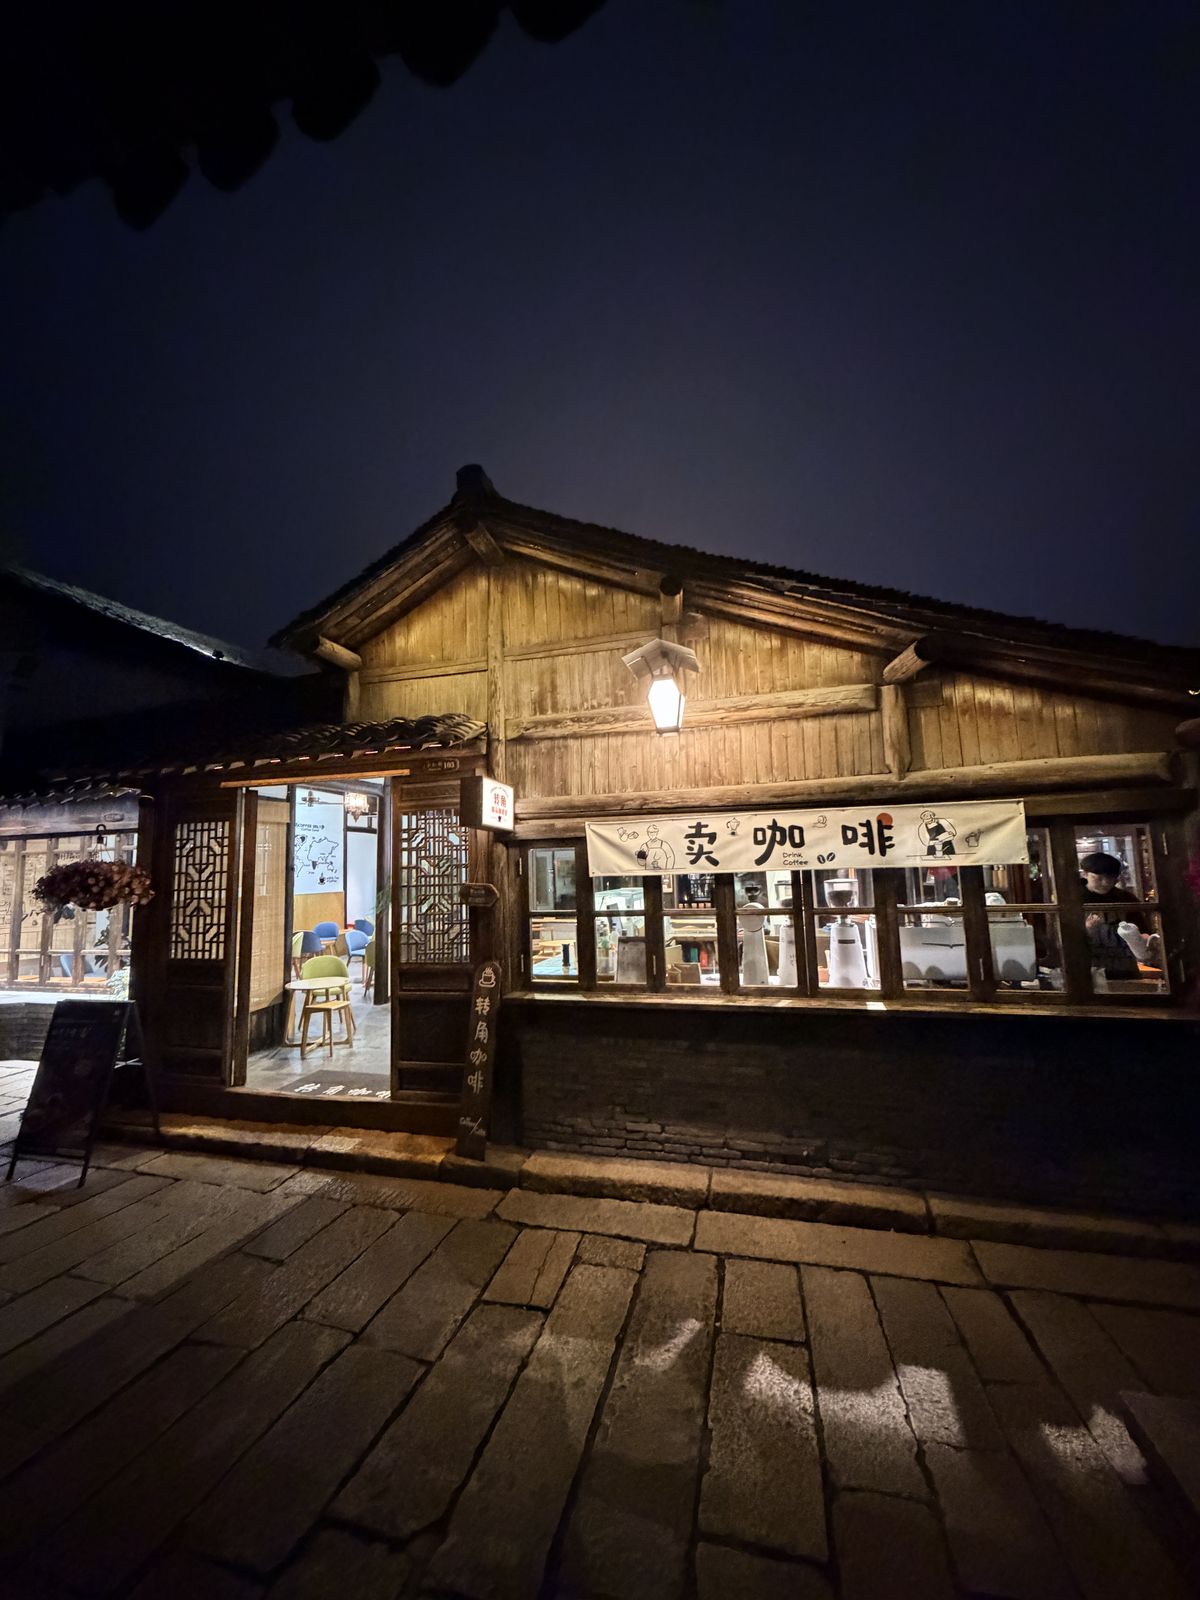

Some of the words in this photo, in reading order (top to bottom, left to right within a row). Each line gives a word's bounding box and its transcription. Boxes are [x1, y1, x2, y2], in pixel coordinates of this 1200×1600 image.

[684, 818, 896, 867] 卖咖啡
[467, 997, 491, 1095] 转角咖啡
